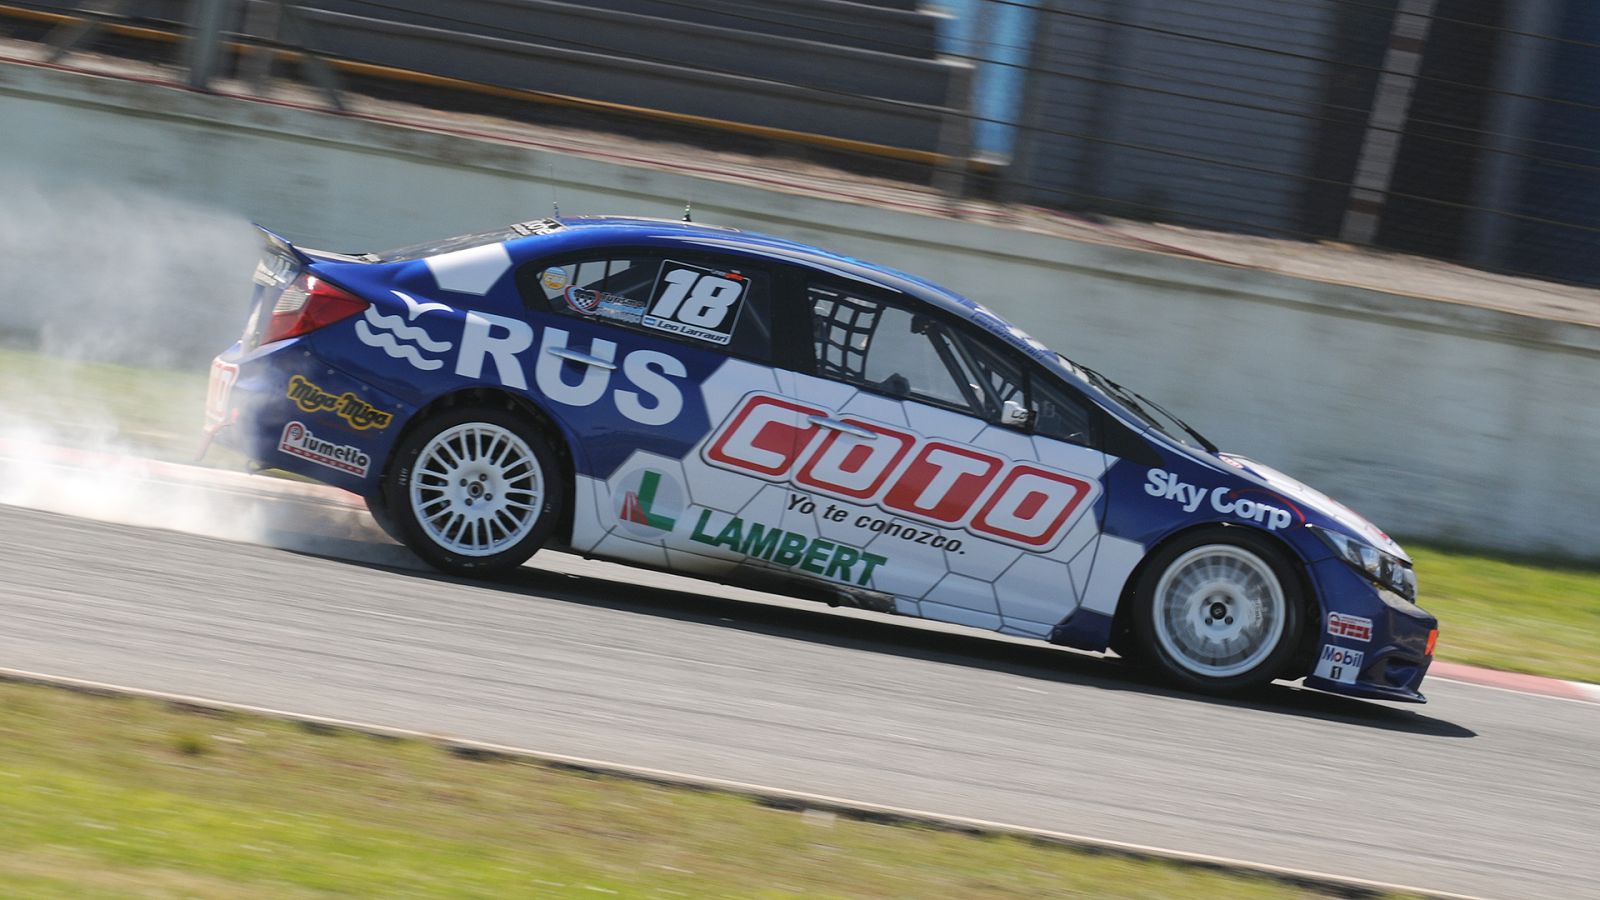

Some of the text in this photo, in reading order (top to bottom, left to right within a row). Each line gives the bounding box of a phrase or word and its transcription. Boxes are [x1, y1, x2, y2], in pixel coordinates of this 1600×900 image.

[651, 269, 743, 329] 18
[657, 320, 730, 343] Leo Larrauri
[455, 310, 688, 426] RUS
[284, 423, 368, 467] Piumetto
[712, 398, 1088, 543] COTO
[788, 494, 966, 555] Yo te conozco.
[1144, 468, 1292, 530] Sky Corp
[690, 509, 888, 586] LAMBERT
[1321, 646, 1363, 667] Mobil
